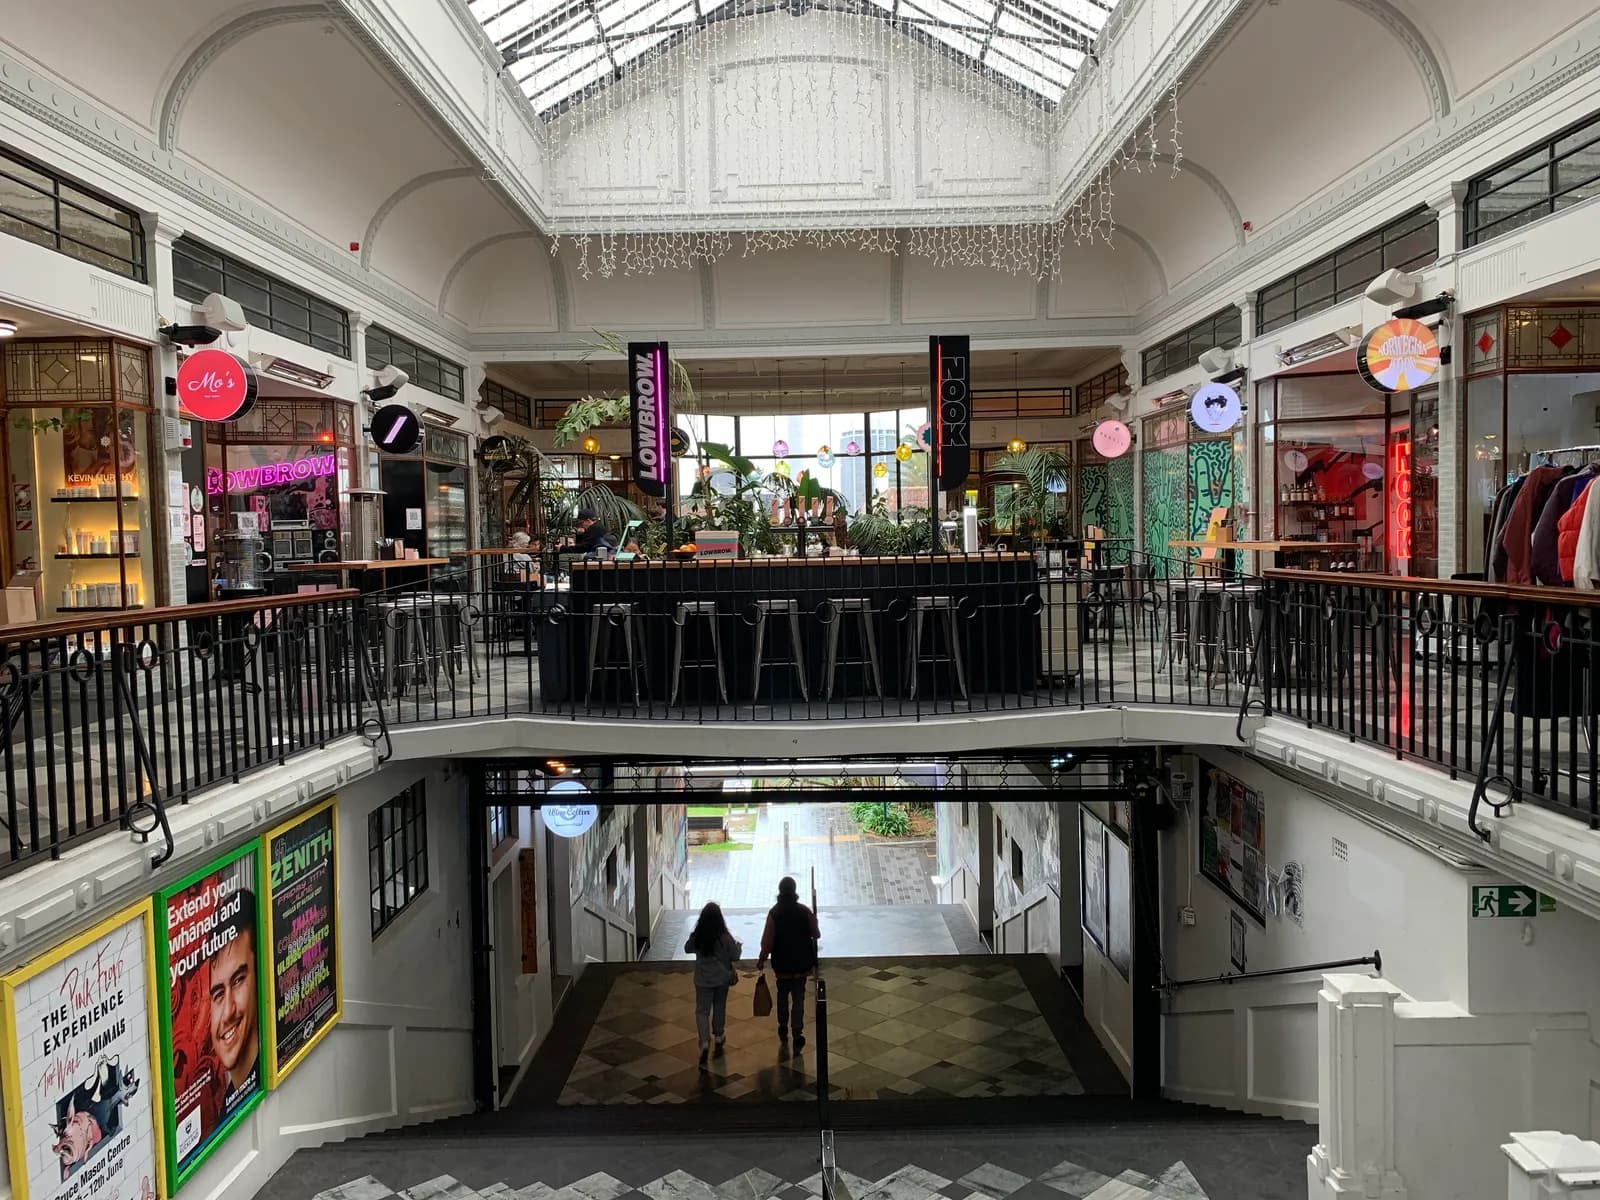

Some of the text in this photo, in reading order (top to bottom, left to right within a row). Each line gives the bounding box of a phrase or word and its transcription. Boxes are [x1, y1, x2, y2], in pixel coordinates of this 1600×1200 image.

[188, 371, 235, 392] Mo's
[941, 356, 968, 447] NOOK
[68, 473, 134, 482] KEVIN MURHY
[271, 829, 332, 890] ZENITH
[167, 885, 210, 929] Extend
[212, 874, 240, 908] your
[168, 910, 218, 955] whānau
[220, 892, 241, 922] and
[169, 948, 200, 987] your
[201, 924, 238, 960] future.
[42, 1004, 68, 1033] THE
[43, 990, 125, 1057] EXPERIENCE
[88, 1018, 126, 1058] ANIMALS
[80, 1158, 106, 1188] Mason
[107, 1134, 131, 1162] Centre
[88, 1158, 124, 1196] 12th June
